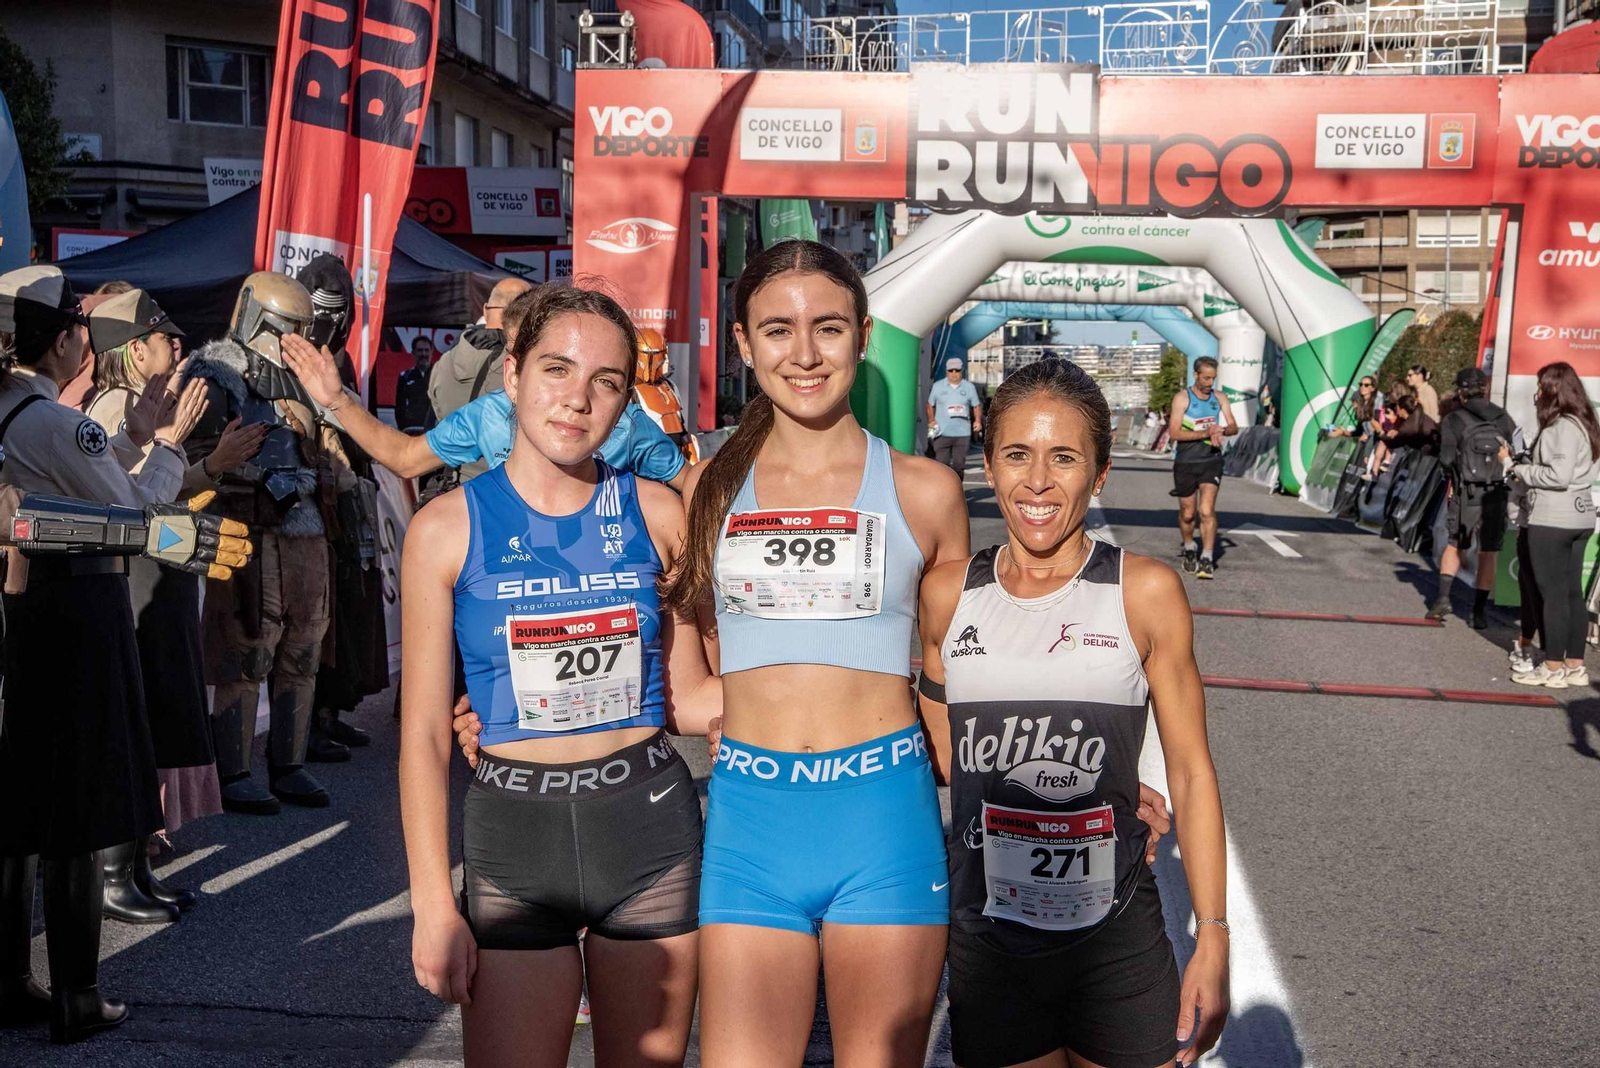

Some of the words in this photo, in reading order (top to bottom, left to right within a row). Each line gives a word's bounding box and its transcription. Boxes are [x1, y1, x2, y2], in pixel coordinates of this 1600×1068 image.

[917, 72, 1093, 135] RUN
[588, 106, 673, 137] VIGO
[748, 118, 833, 133] CONCELLO
[1324, 125, 1417, 140] CONCELLO
[593, 135, 709, 157] DEPORTE
[758, 136, 782, 149] DE
[785, 136, 823, 149] VIGO
[1334, 143, 1357, 156] DE
[1363, 143, 1405, 156] VIGO
[1518, 146, 1600, 169] DEPO
[210, 166, 235, 178] Vigo
[237, 169, 251, 177] en
[212, 177, 246, 188] contra
[476, 192, 529, 202] CONCELLO
[483, 203, 497, 211] DE
[500, 203, 524, 211] VIGO
[1081, 226, 1125, 236] contra
[1128, 225, 1141, 236] el
[1144, 225, 1192, 238] cáncer
[1039, 271, 1073, 287] Corte
[1075, 268, 1126, 292] Inglés
[763, 537, 836, 567] 398
[496, 571, 642, 600] SOLISS
[863, 582, 872, 598] 398
[515, 601, 562, 612] Seguros
[567, 597, 599, 607] desde
[605, 594, 628, 604] 1933
[523, 642, 540, 650] Vigo
[550, 640, 577, 649] marcha
[576, 636, 600, 646] contra
[606, 633, 629, 641] cancro
[1083, 638, 1120, 649] DELIKIA
[1095, 633, 1120, 641] DEPORTIVO
[554, 643, 623, 681] 207
[958, 715, 1106, 773] delikia
[715, 743, 780, 780] PRO
[790, 745, 884, 783] NIKE
[539, 759, 631, 794] PRO
[1035, 770, 1079, 788] fresh
[997, 831, 1013, 839] Vigo
[1022, 835, 1049, 844] marcha
[1049, 837, 1074, 845] contra
[1080, 834, 1104, 842] cancro
[1030, 846, 1090, 879] 271
